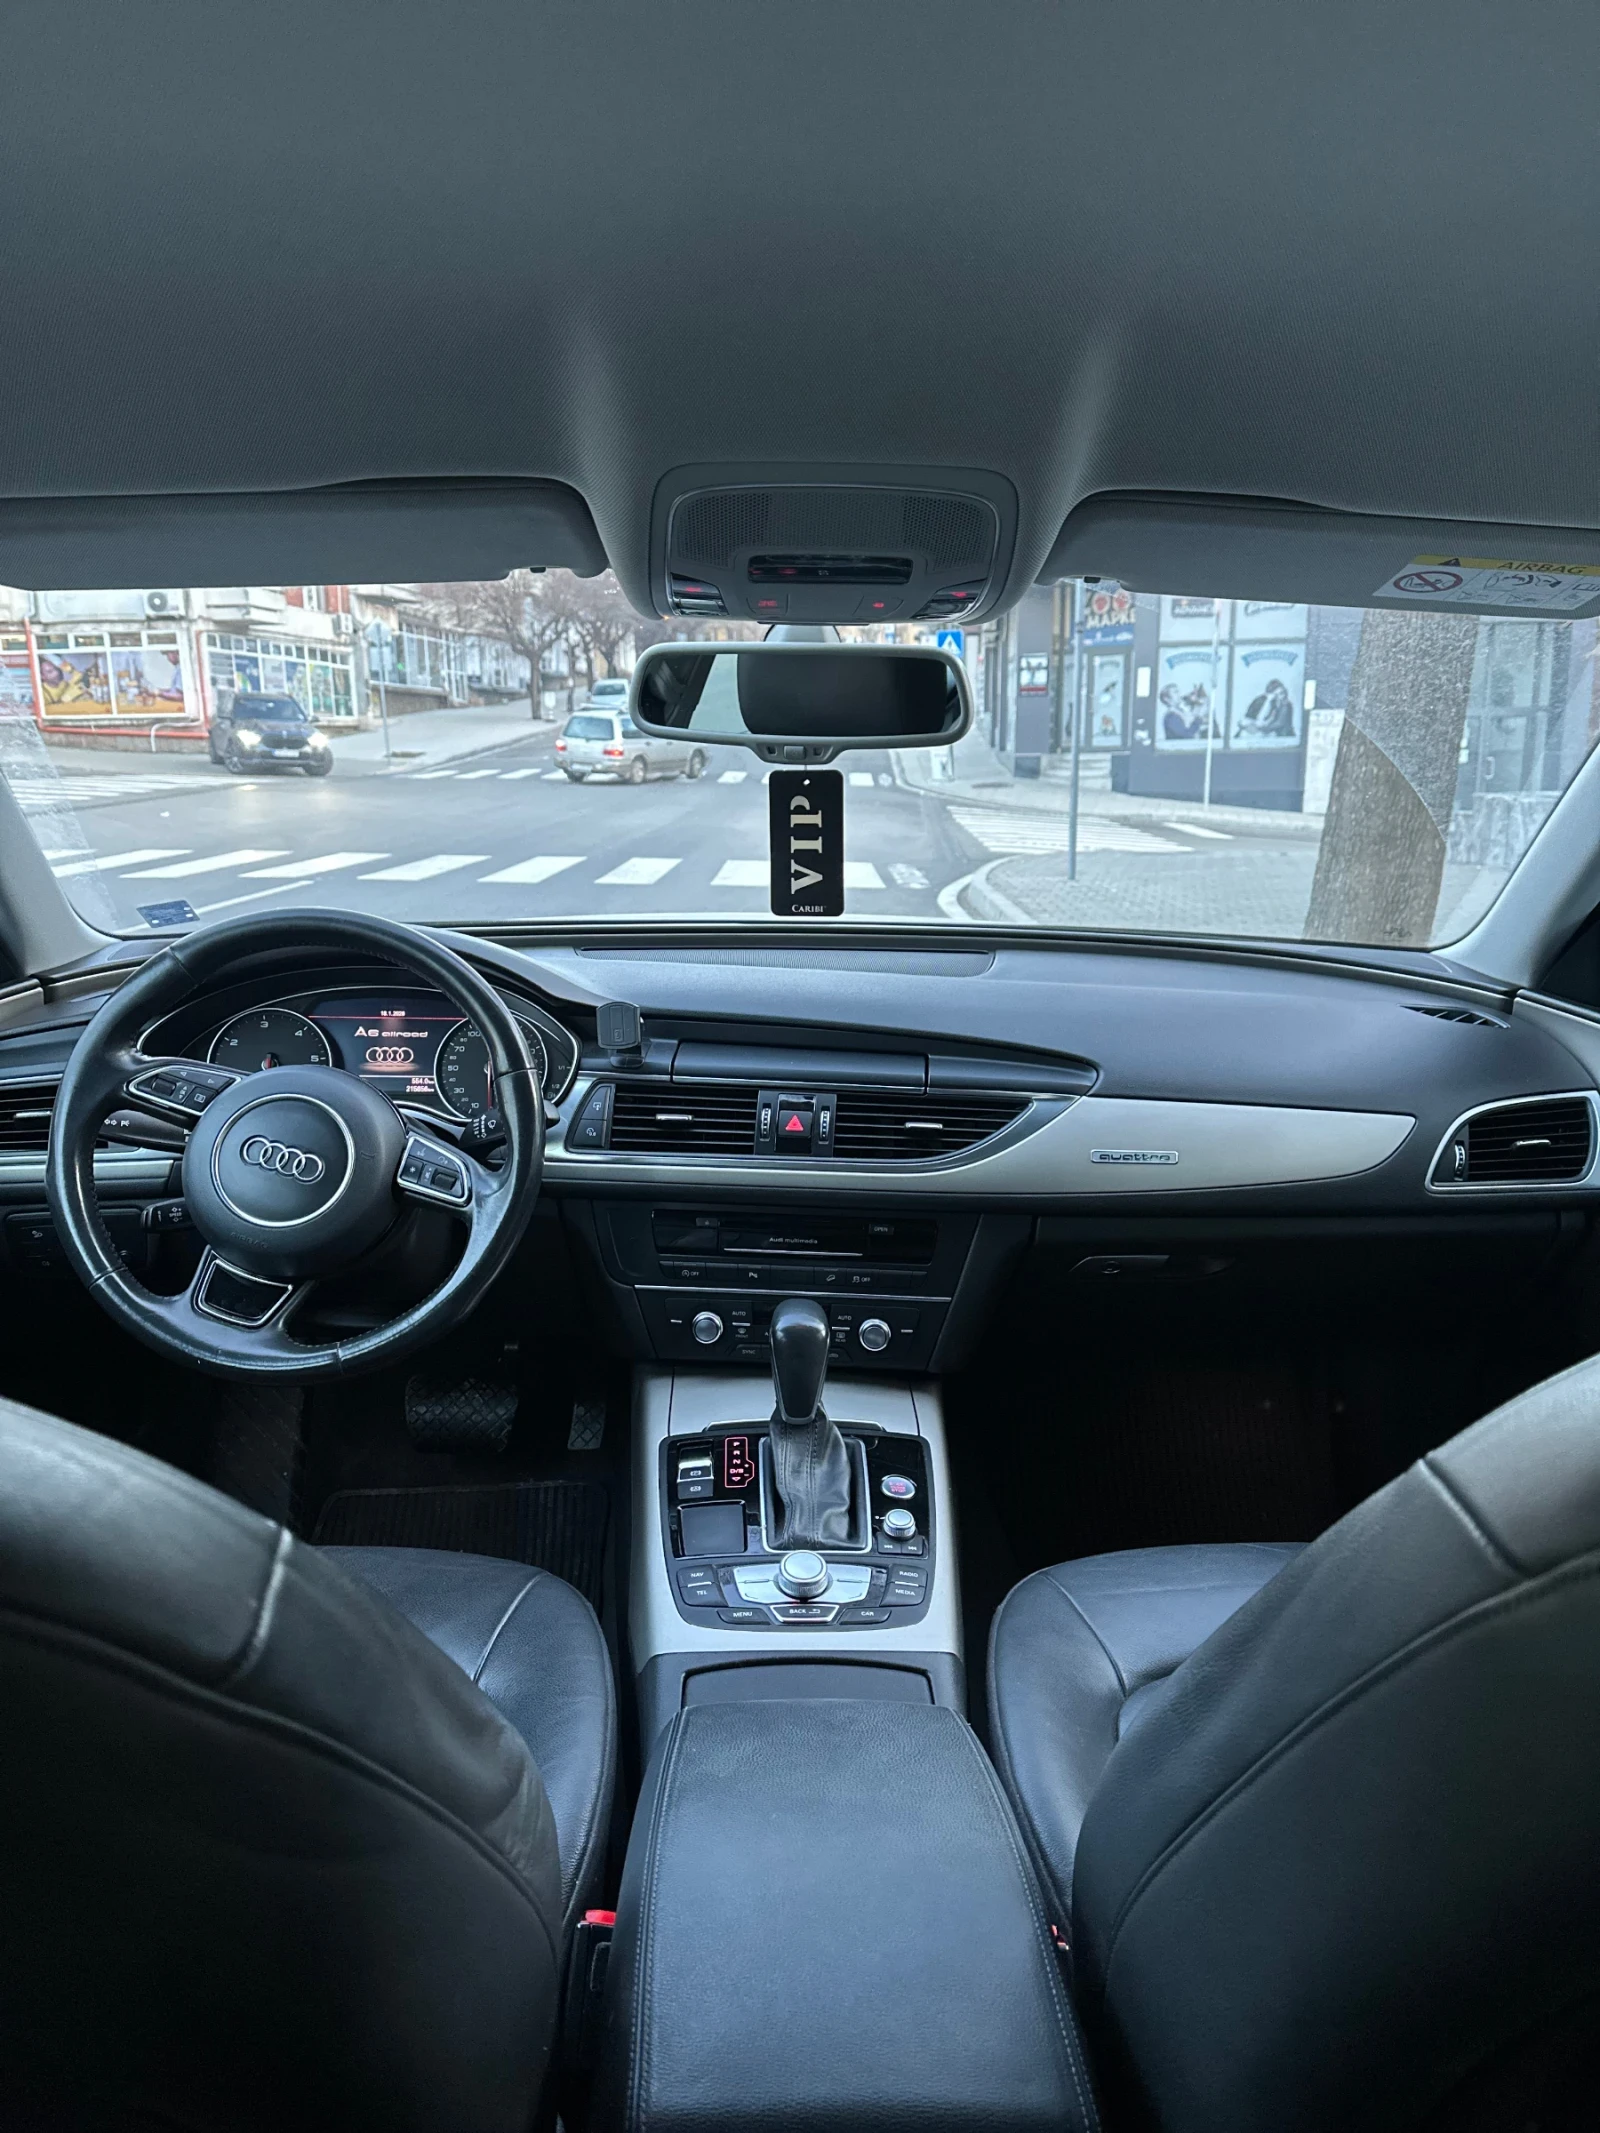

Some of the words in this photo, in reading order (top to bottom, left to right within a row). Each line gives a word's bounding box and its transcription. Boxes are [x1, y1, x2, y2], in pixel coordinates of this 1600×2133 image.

[1498, 562, 1587, 574] AIRBAG
[790, 796, 823, 895] VIP
[354, 1026, 380, 1037] A6
[1099, 1154, 1171, 1162] quattro
